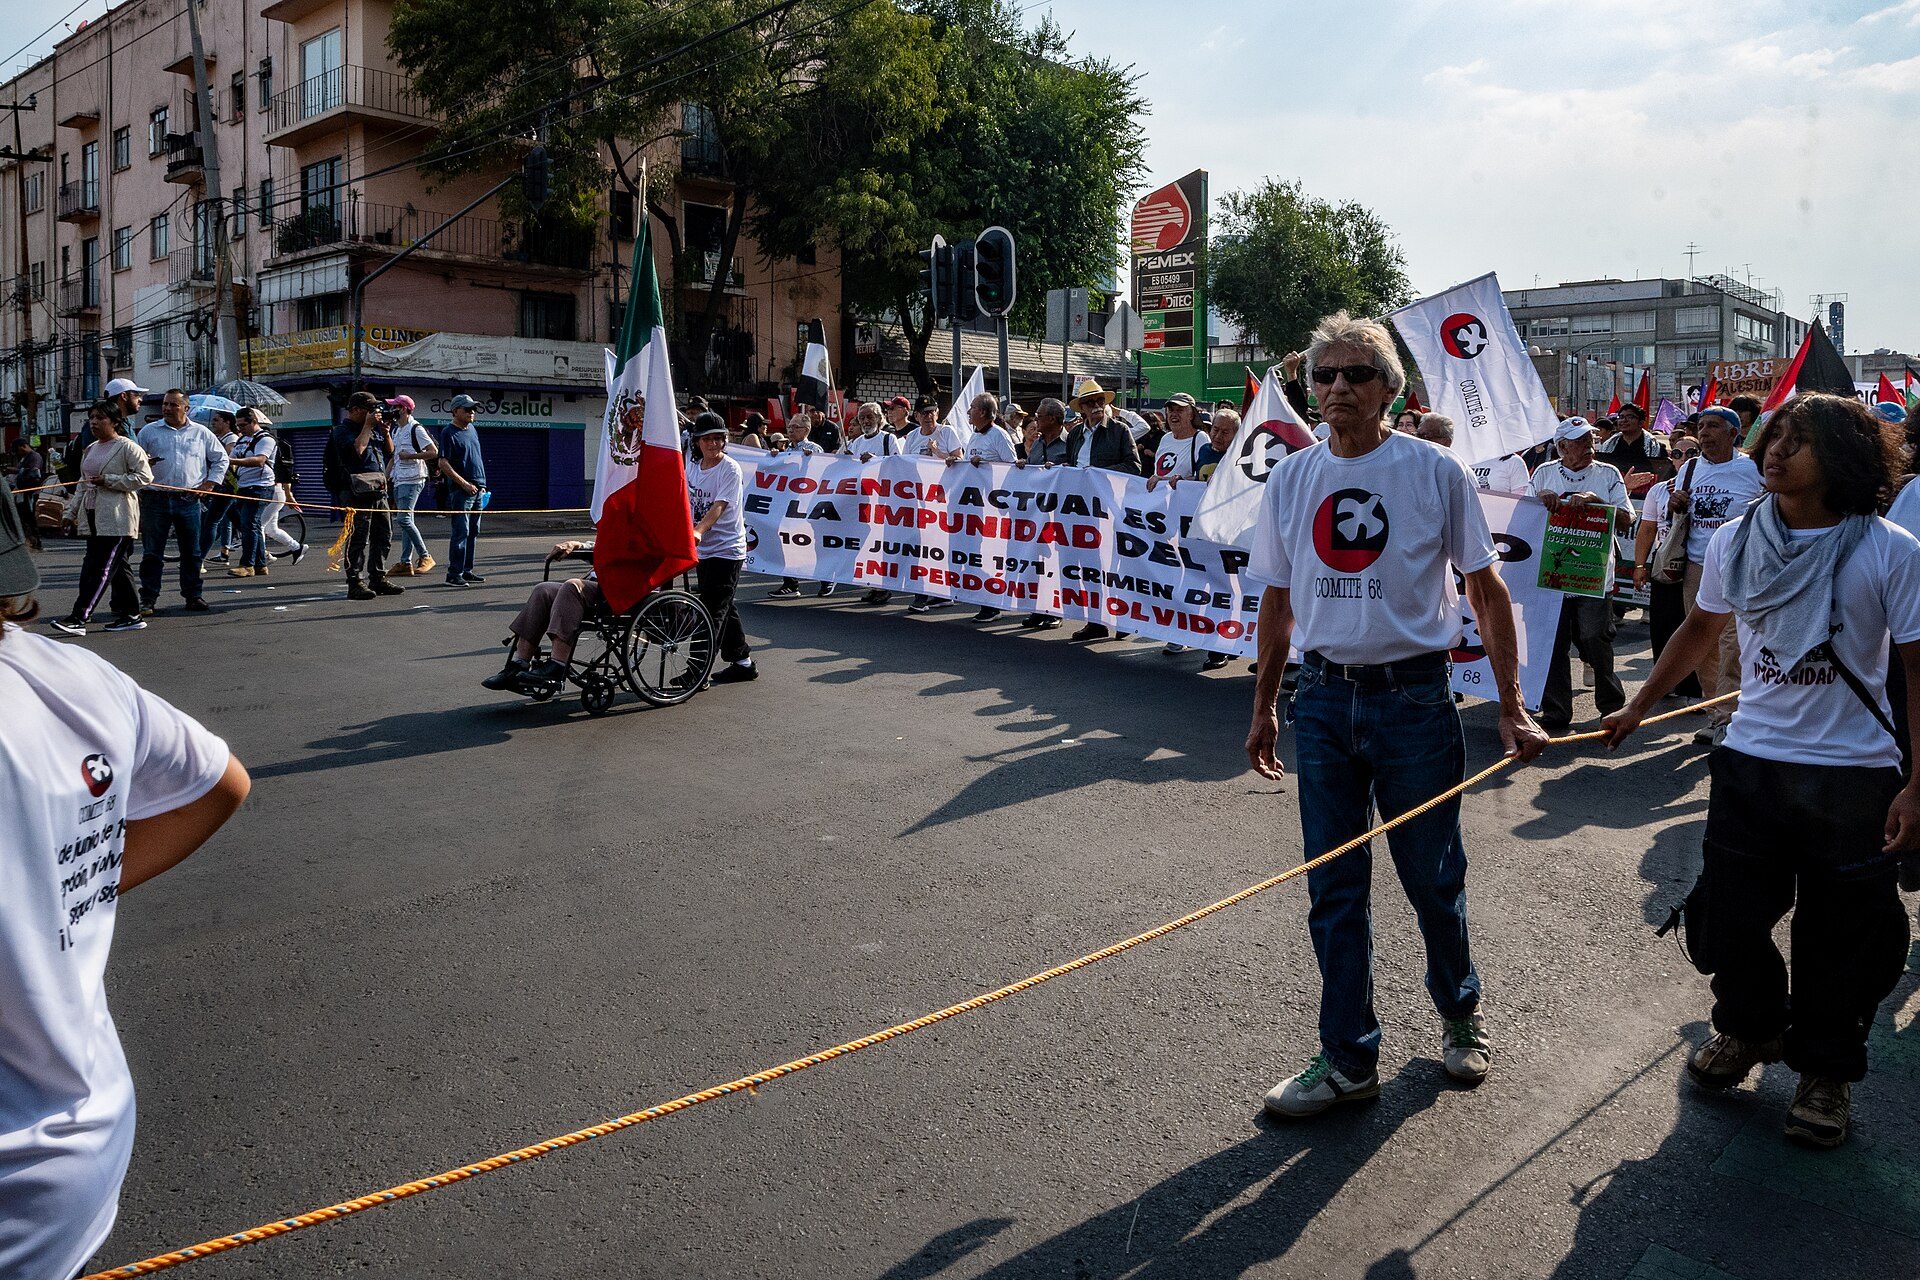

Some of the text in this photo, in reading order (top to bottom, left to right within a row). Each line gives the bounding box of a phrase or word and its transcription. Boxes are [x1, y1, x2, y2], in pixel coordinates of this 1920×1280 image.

[1136, 252, 1195, 270] PEMEX
[1151, 274, 1180, 286] ES 05499
[855, 344, 876, 354] TECATE
[1711, 360, 1775, 381] LIBRE
[1715, 377, 1778, 397] PALESTIN
[1470, 414, 1488, 428] 68
[755, 470, 948, 504] VIOLENCIA
[958, 486, 1109, 520] ACTUAL
[1123, 507, 1167, 535] ES
[744, 493, 773, 515] E
[785, 499, 842, 522] LA
[858, 502, 1104, 550] IMPUNIDAD
[1116, 531, 1207, 572] DEL
[1547, 525, 1602, 539] POR PALESTINA
[778, 531, 812, 546] 10
[823, 535, 861, 551] DE
[869, 540, 945, 561] JUNIO
[951, 550, 983, 568] DE
[992, 555, 1054, 578] 1971,
[1062, 564, 1174, 600] CRIMEN
[1184, 588, 1232, 609] DE
[1368, 578, 1383, 600] 68
[854, 559, 899, 578] ¡NI
[909, 563, 1039, 600] PERDÓN!
[1053, 587, 1100, 610] ¡NI
[1105, 597, 1257, 642] OLVIDO!
[1462, 669, 1481, 685] 68
